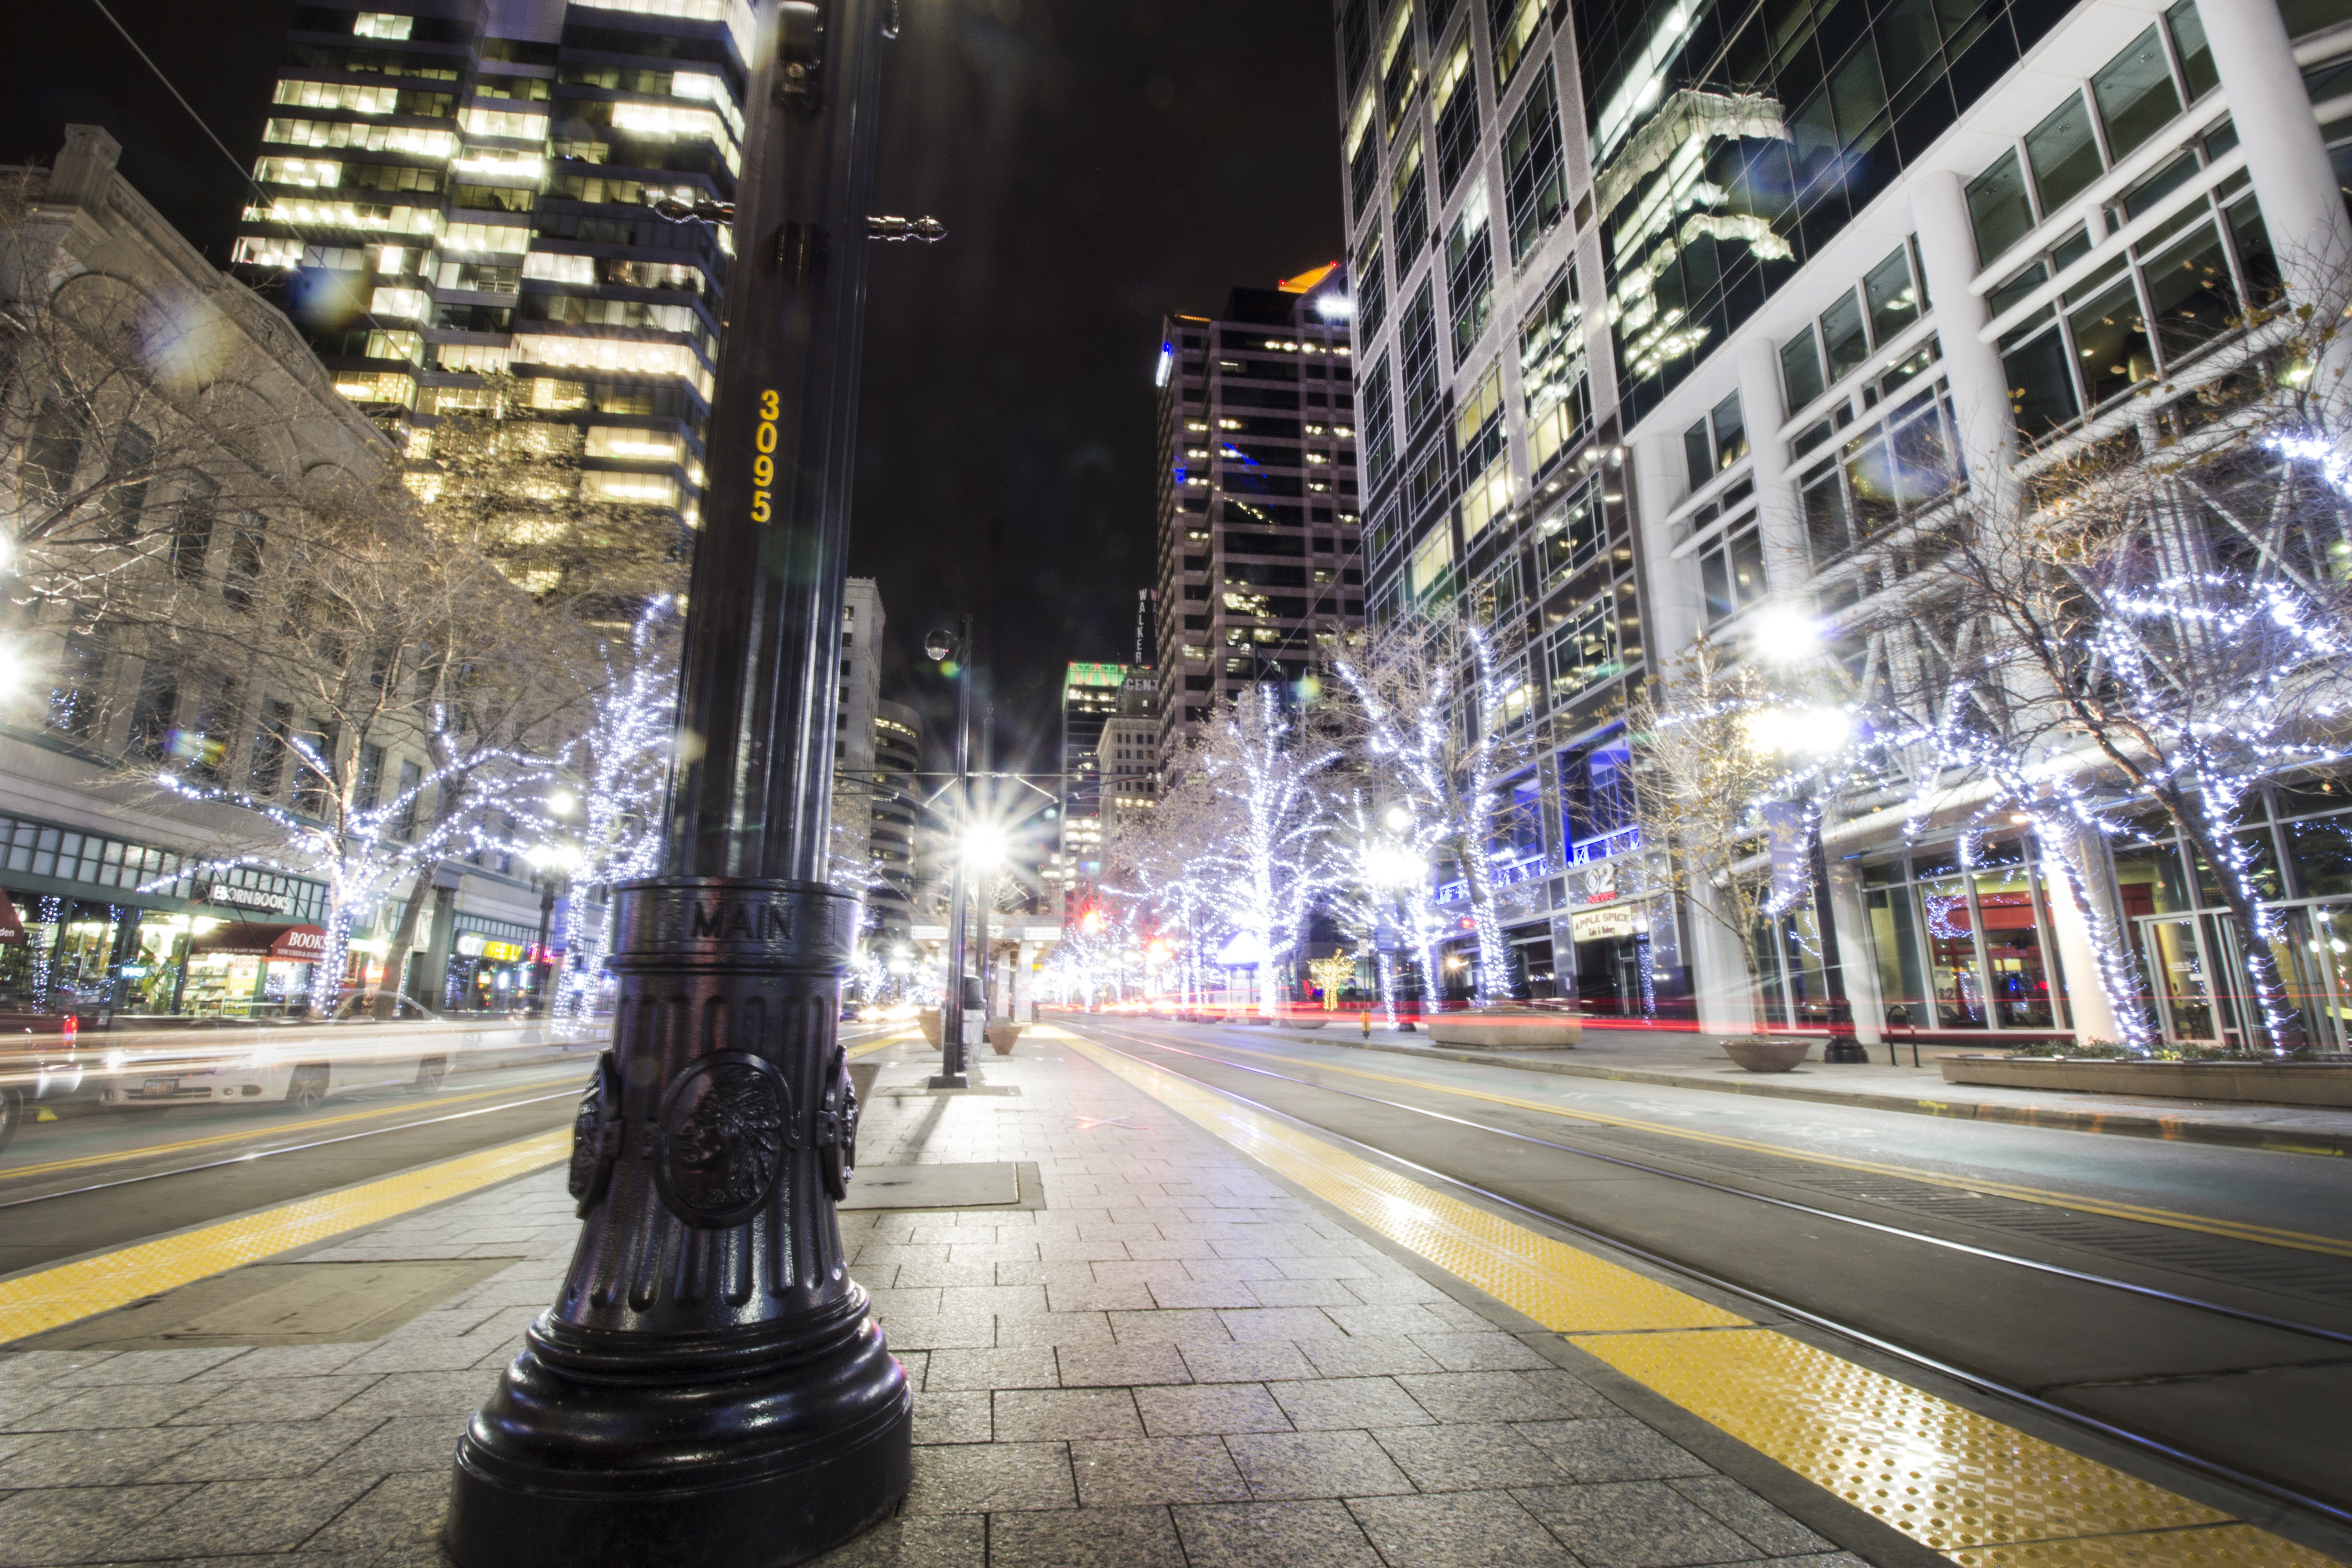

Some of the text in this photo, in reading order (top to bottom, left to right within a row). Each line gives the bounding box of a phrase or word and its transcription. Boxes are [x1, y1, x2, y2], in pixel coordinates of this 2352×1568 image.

[750, 389, 779, 523] 3095
[1136, 588, 1147, 664] WALKER
[214, 885, 289, 910] EBORN BOOKS
[1588, 891, 1616, 904] NEWS
[691, 901, 794, 940] MAIN
[1575, 913, 1630, 931] APPLE SPICE
